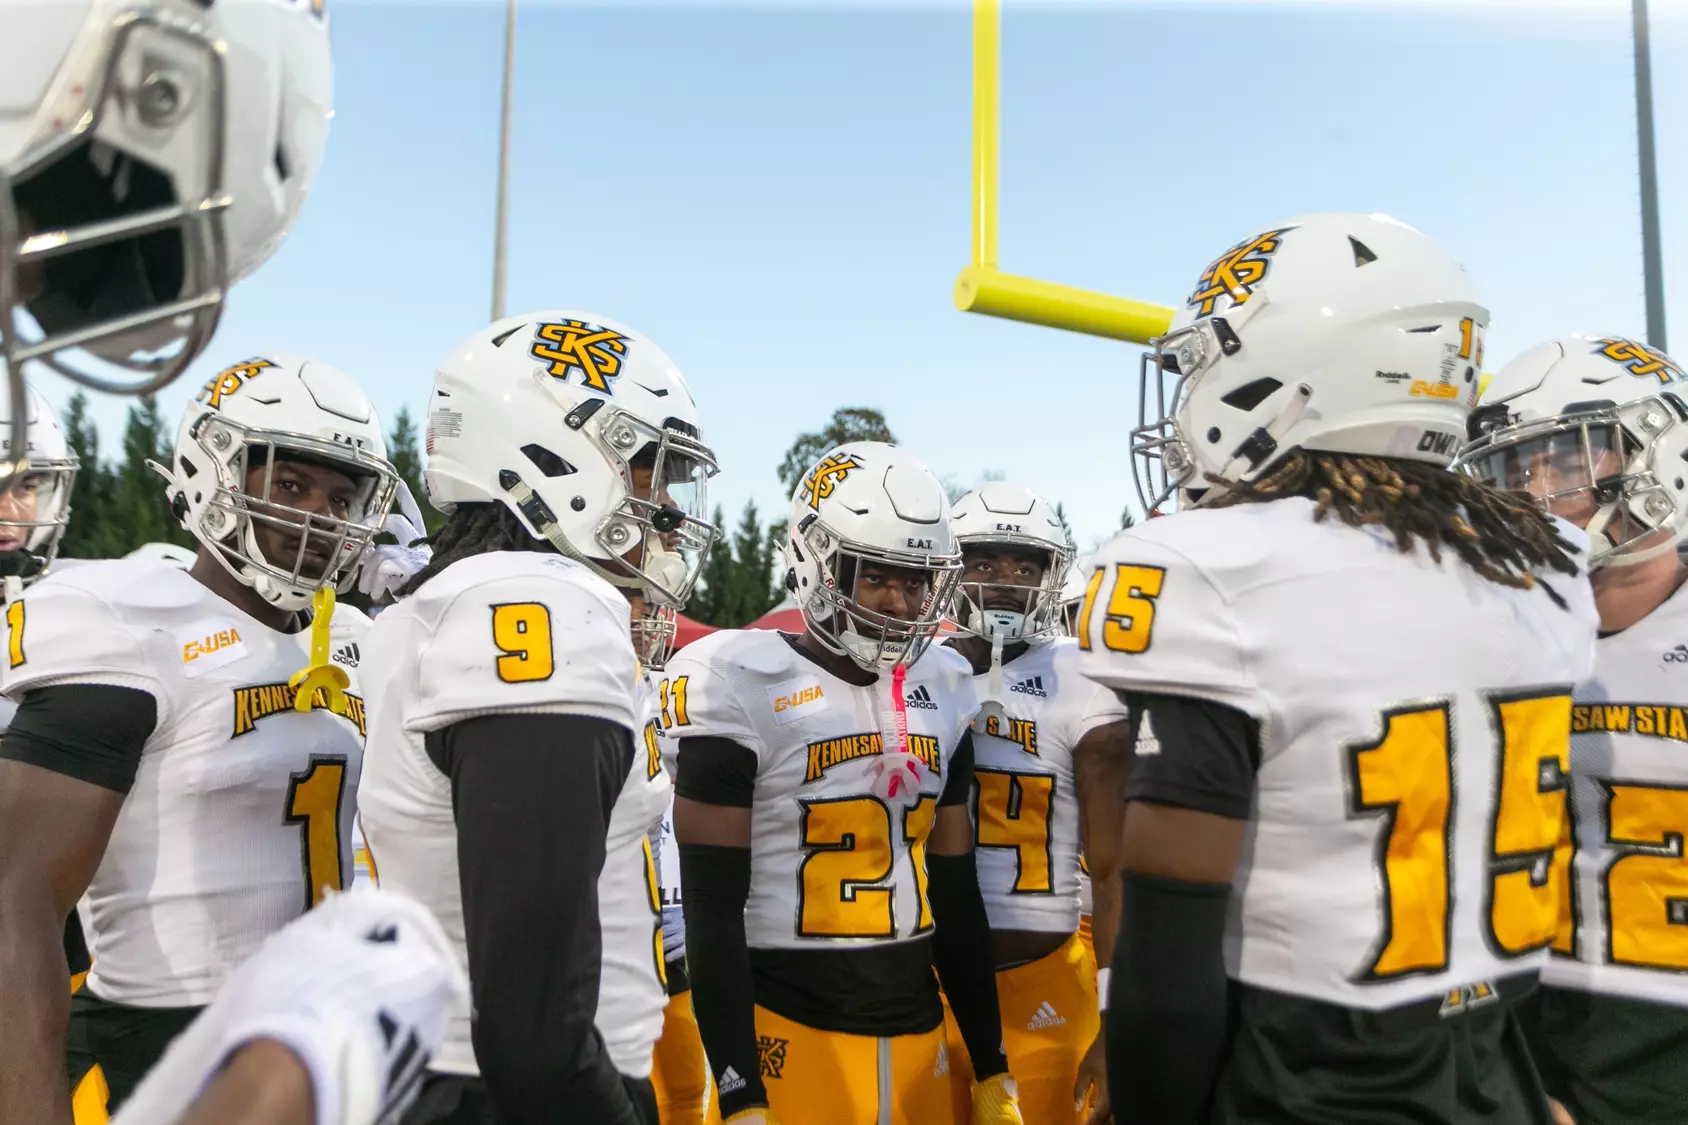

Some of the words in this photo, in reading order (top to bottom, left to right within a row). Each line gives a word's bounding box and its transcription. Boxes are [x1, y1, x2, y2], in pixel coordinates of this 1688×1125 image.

[489, 601, 555, 683] 9
[1010, 684, 1047, 698] adidas
[796, 793, 939, 940] 21
